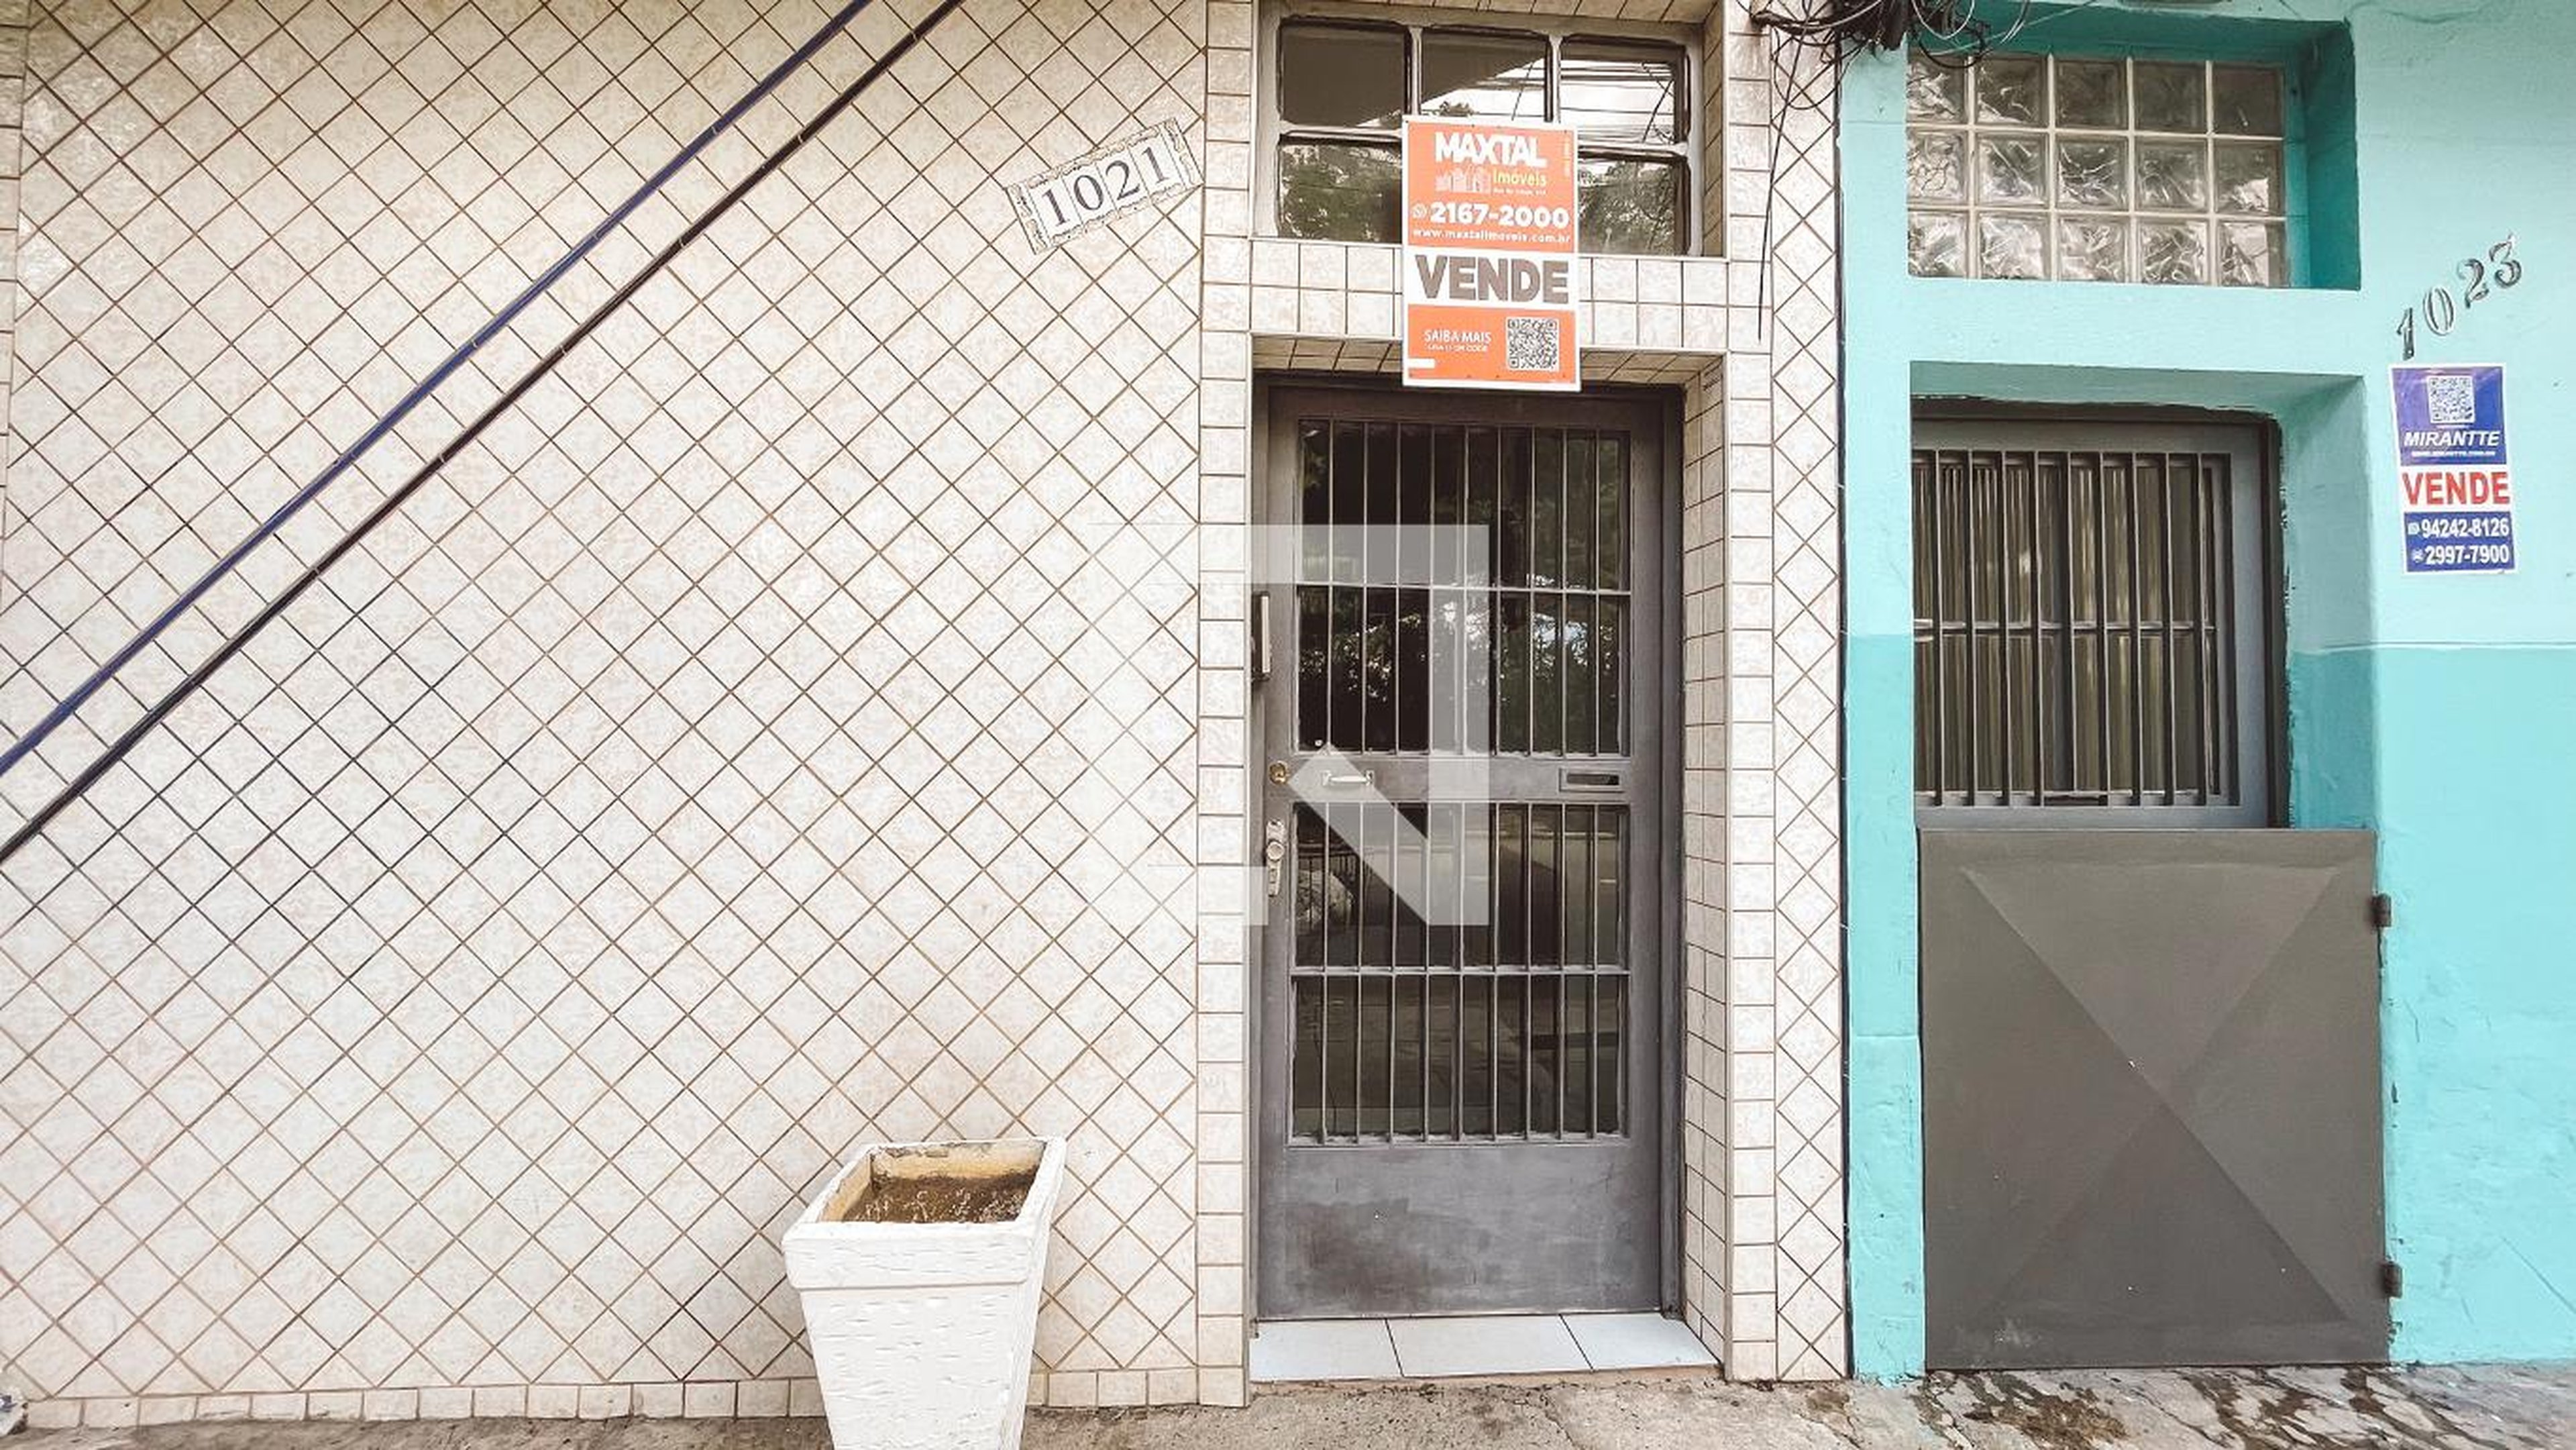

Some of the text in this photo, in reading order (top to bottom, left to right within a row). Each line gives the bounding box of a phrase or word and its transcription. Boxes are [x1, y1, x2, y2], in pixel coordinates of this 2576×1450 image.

[1435, 132, 1547, 167] MAXTAL
[1041, 146, 1172, 226] 1021
[1430, 202, 1570, 229] 2167-2000
[1415, 254, 1569, 304] VENDE
[2397, 233, 2522, 360] 1023
[1424, 329, 1492, 344] SAIBA MAIS
[2404, 429, 2500, 447] MIRANTTE
[2402, 472, 2510, 505] VENDE
[2422, 517, 2510, 537] 94242-8126
[2424, 544, 2510, 565] 2997-7900
